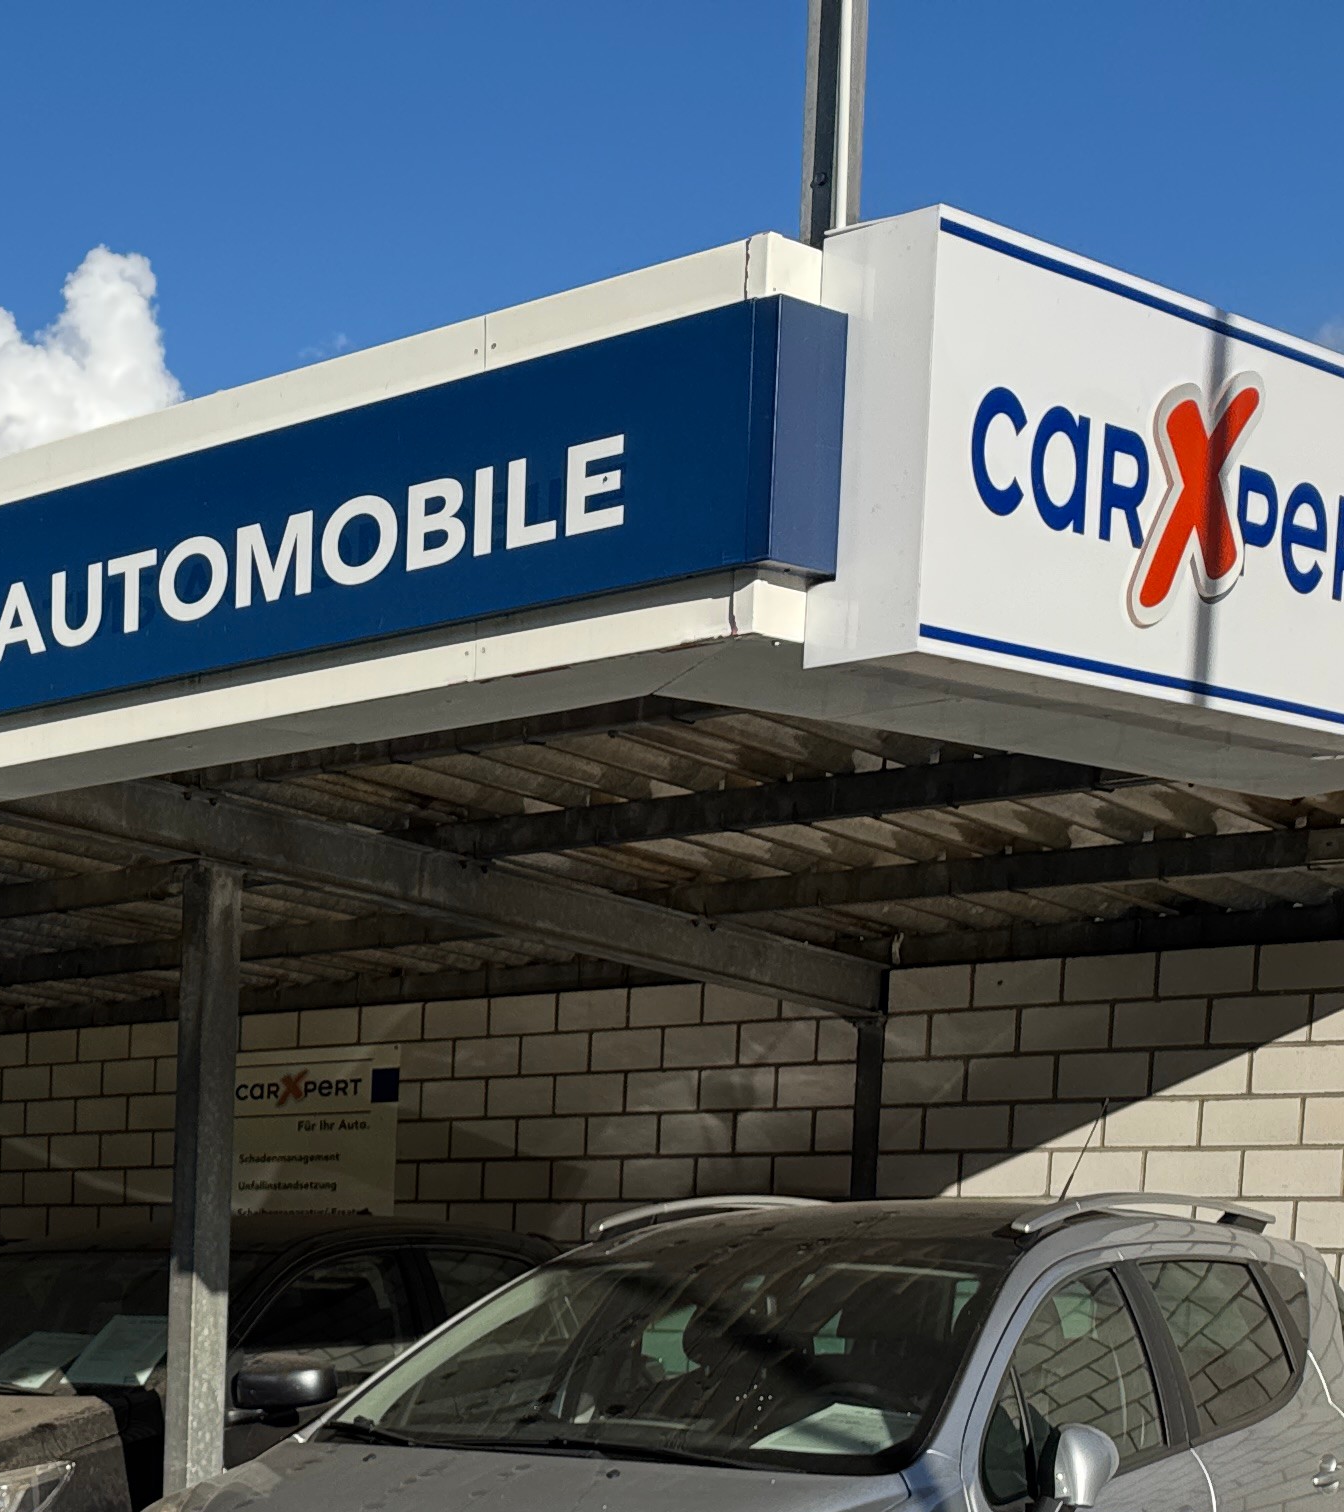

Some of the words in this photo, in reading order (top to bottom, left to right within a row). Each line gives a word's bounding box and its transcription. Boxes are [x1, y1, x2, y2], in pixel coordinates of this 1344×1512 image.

[297, 1119, 316, 1132] Für
[319, 1119, 335, 1131] Ihr
[338, 1119, 370, 1131] Auto.
